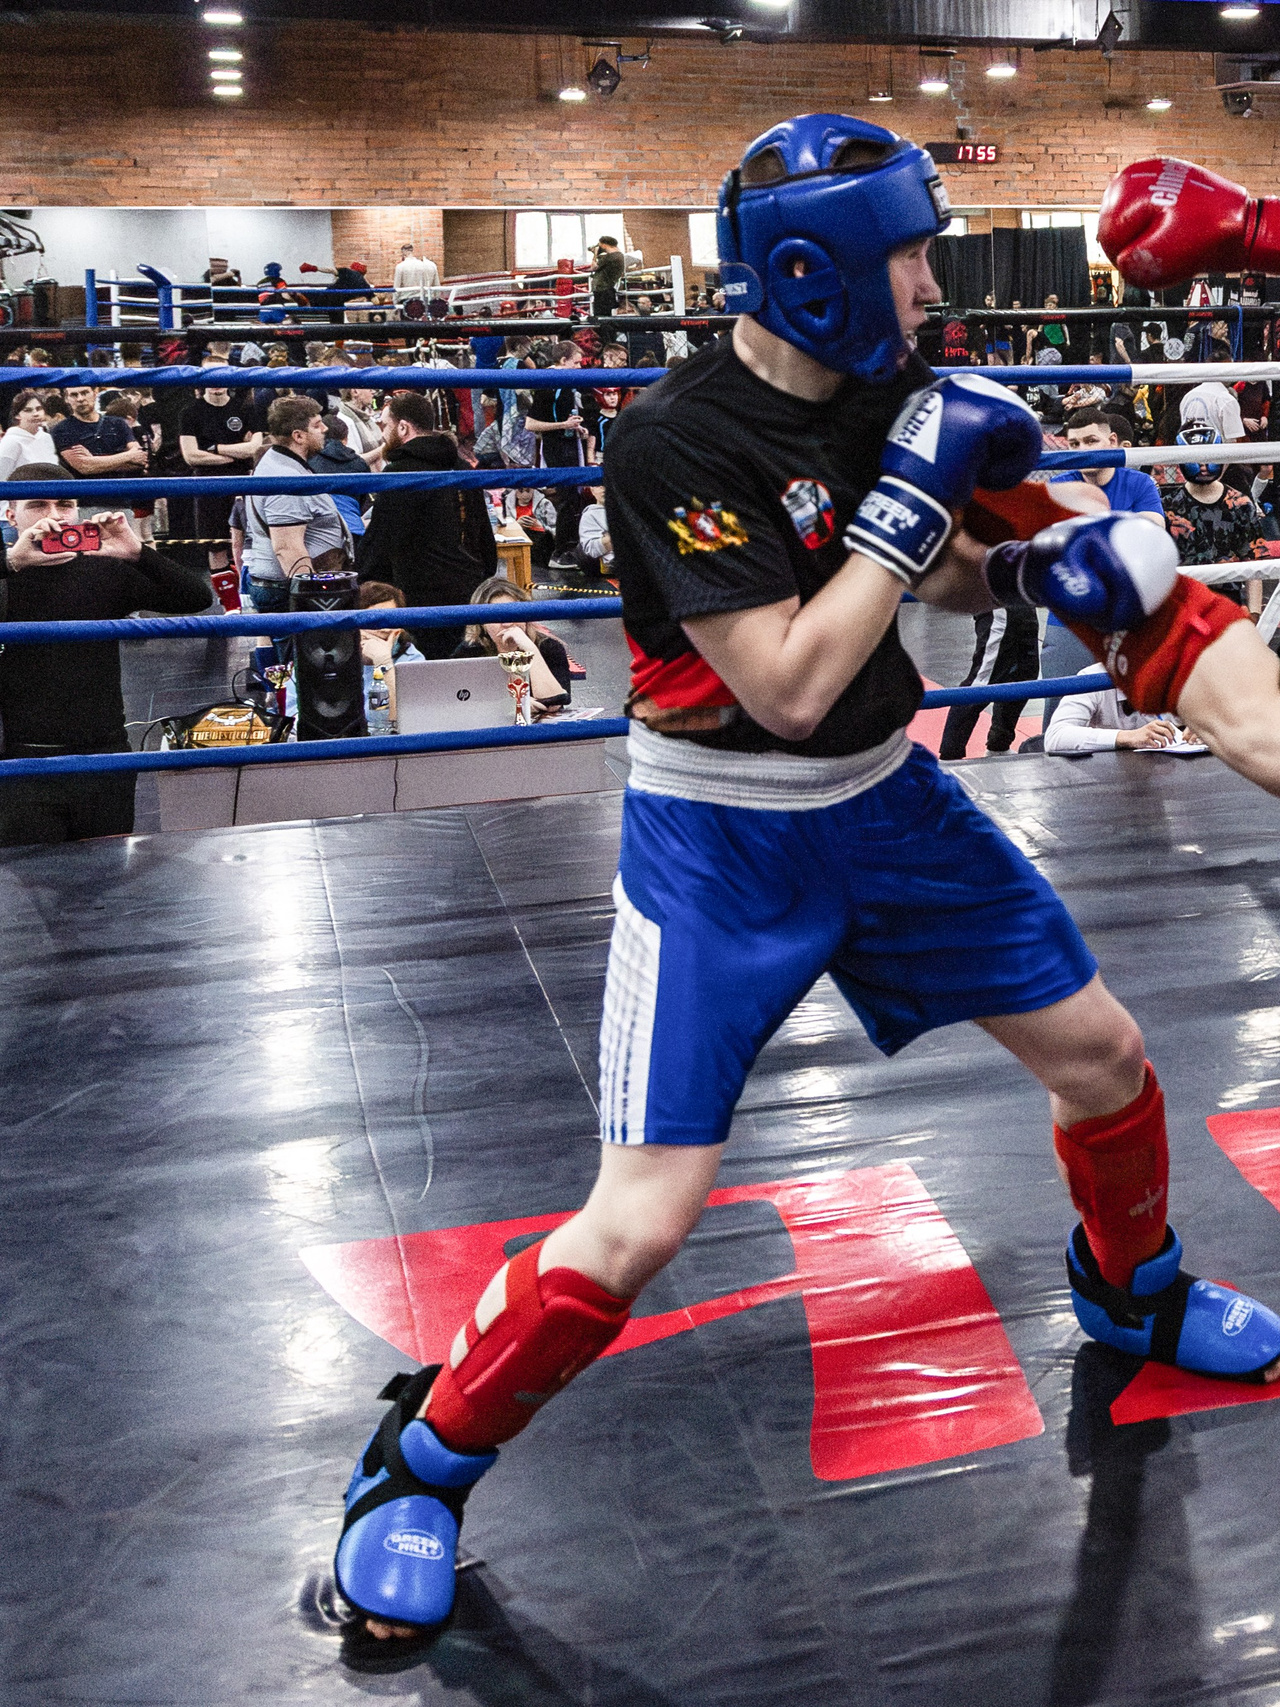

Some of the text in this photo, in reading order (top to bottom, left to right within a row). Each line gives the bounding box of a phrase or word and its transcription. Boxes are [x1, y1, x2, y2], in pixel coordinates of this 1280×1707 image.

[193, 731, 210, 741] THE
[391, 1533, 439, 1551] GREEN
[398, 1542, 429, 1555] HILL
